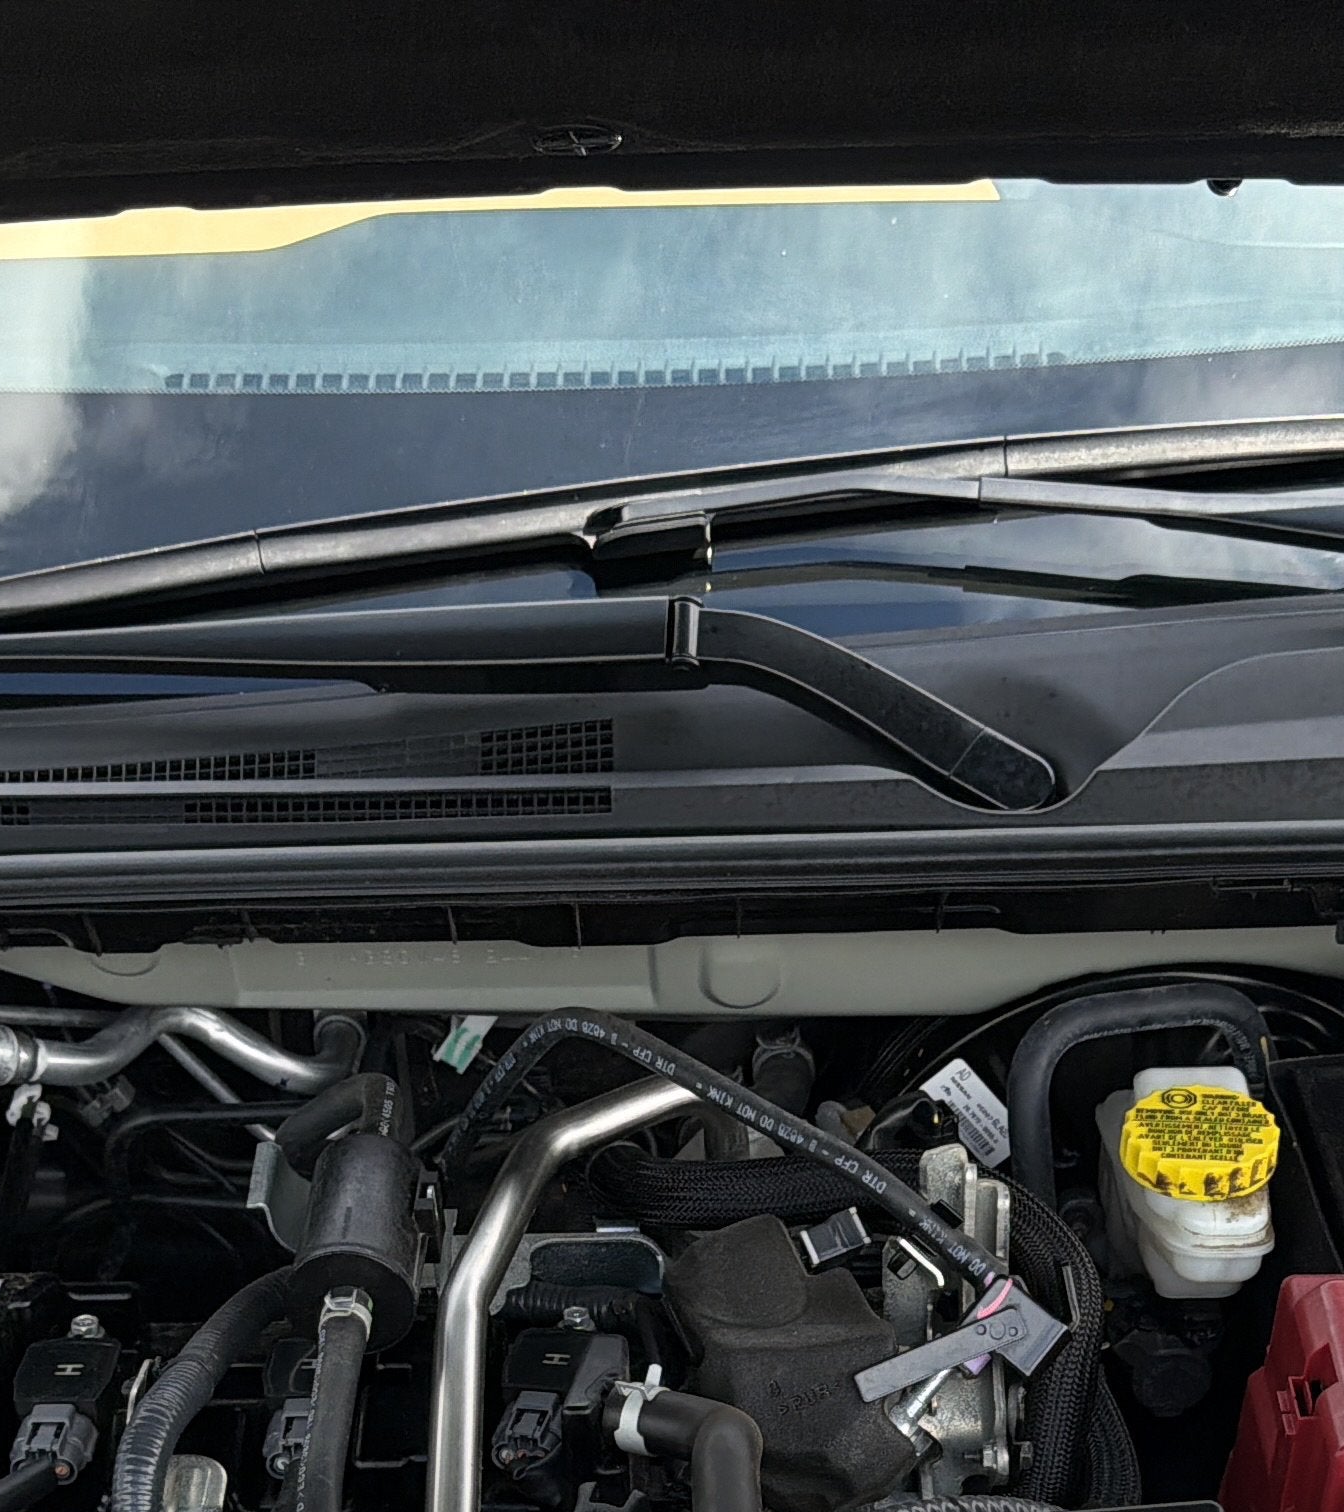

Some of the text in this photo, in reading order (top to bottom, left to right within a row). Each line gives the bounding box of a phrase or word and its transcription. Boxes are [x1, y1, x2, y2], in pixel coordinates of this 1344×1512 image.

[736, 1105, 757, 1120] NOT
[759, 1114, 775, 1131] DO
[835, 1155, 859, 1174] CFP
[862, 1170, 887, 1194] DTR
[948, 1242, 971, 1263] NOT
[968, 1259, 986, 1276] DO
